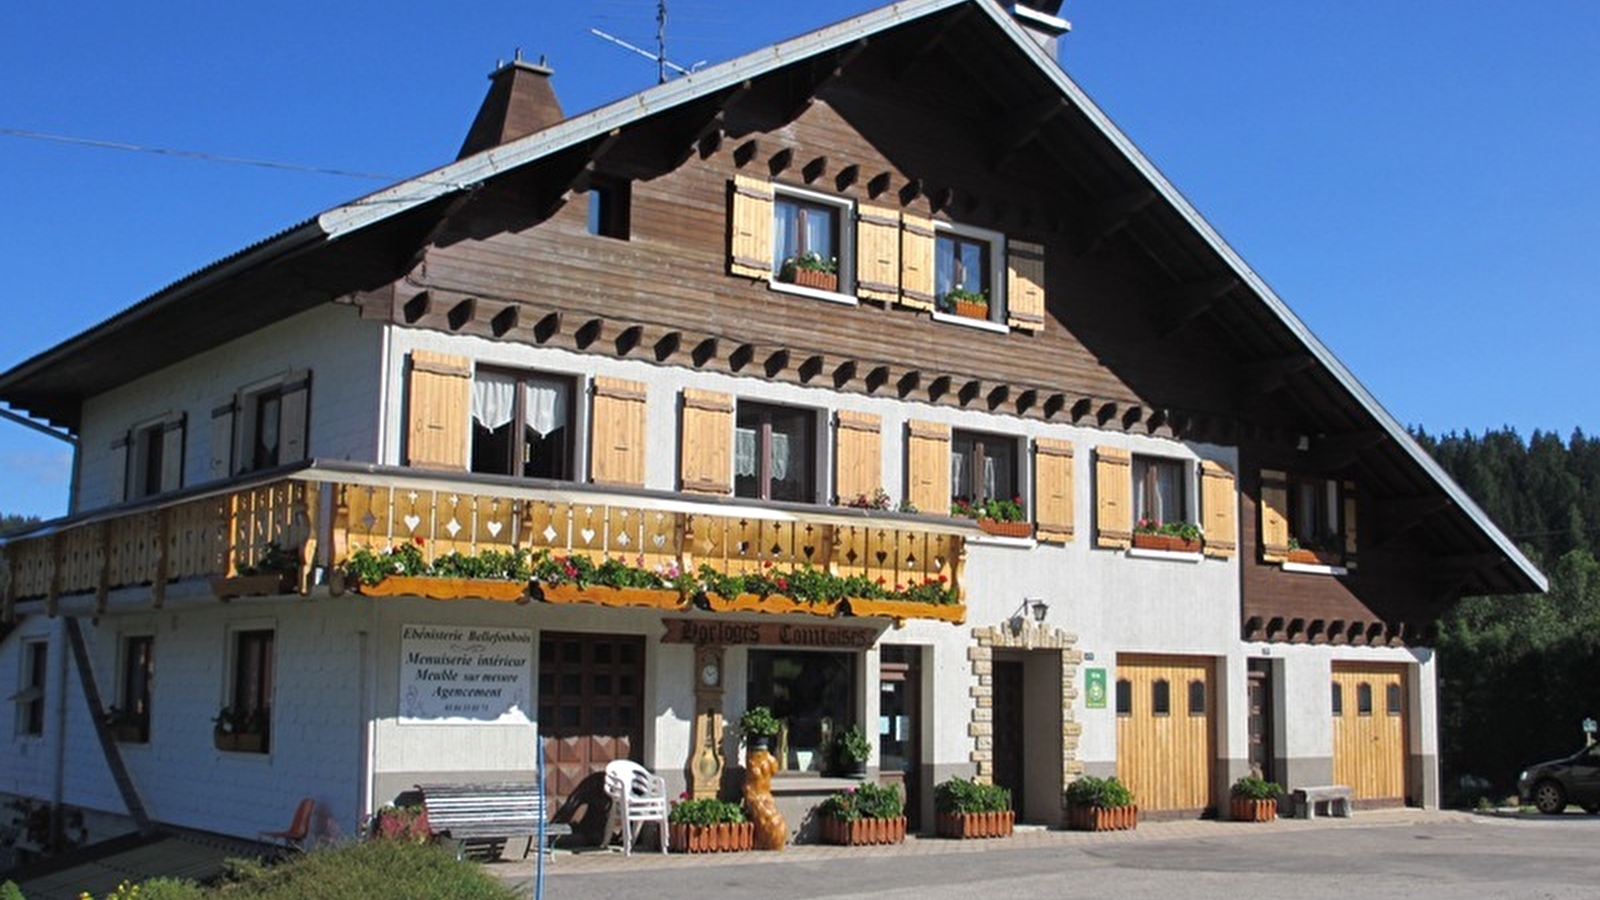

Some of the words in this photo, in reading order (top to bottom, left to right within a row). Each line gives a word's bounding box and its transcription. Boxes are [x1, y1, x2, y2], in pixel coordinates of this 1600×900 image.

[403, 627, 464, 642] Ebénisterie
[681, 619, 761, 645] Horloges
[778, 623, 868, 648] Comtoises
[405, 652, 473, 666] Menuiserie
[415, 669, 459, 682] Meuble
[463, 673, 479, 682] sur
[481, 674, 519, 683] mesure
[432, 686, 502, 699] Agencement
